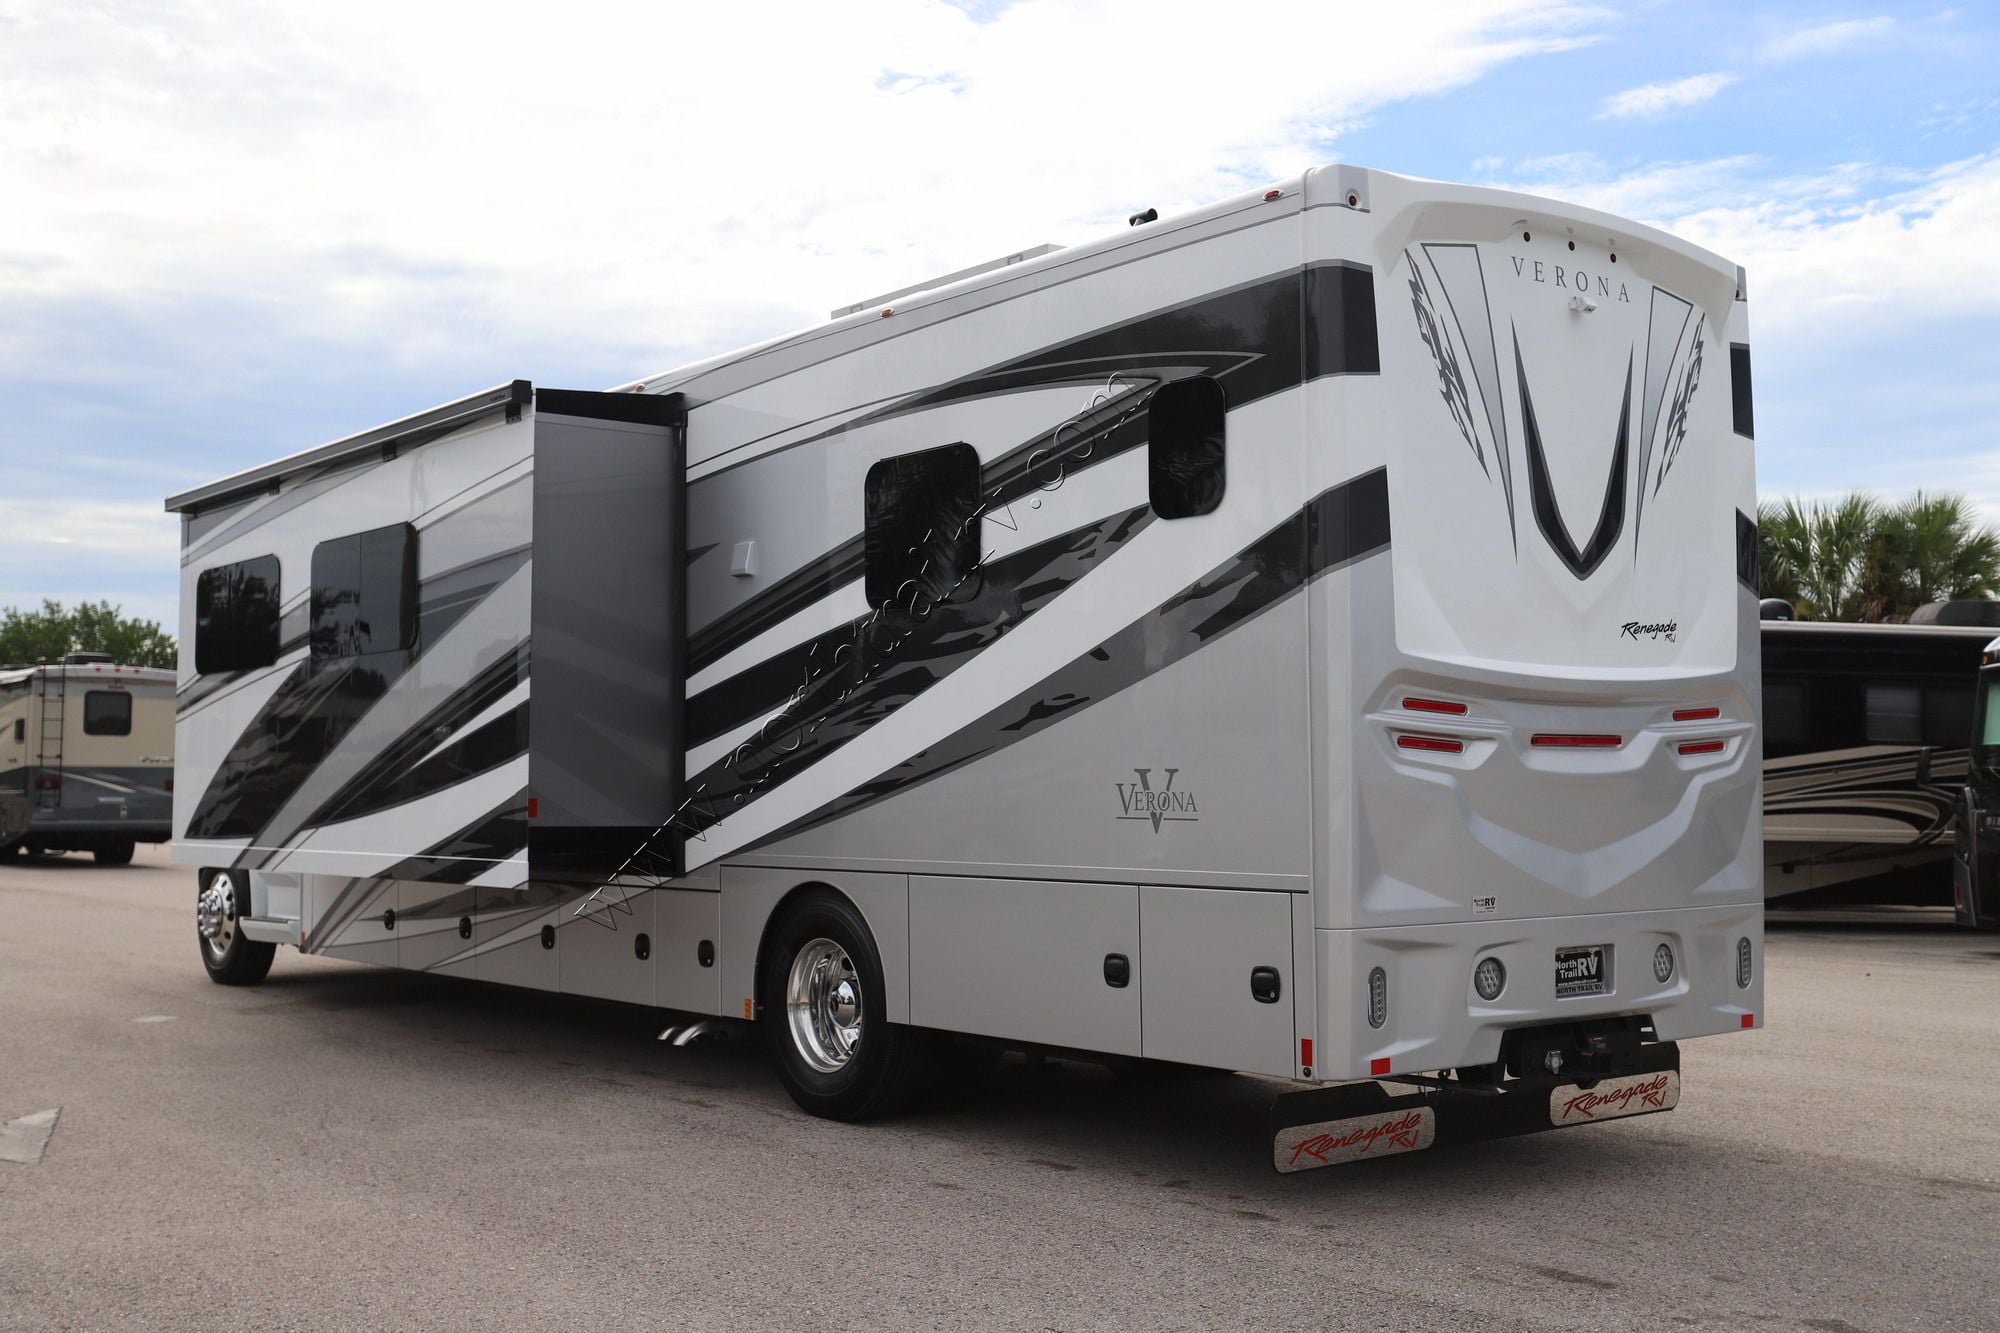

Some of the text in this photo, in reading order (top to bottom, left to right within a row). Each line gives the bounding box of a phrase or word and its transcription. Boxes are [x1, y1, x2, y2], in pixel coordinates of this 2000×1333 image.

[1511, 256, 1630, 303] VERONA
[1621, 618, 1677, 641] Renegade
[1664, 633, 1677, 643] RV
[1555, 956, 1598, 977] North RV
[1560, 969, 1577, 979] Trail
[1562, 1074, 1668, 1119] Renegade
[1641, 1091, 1666, 1108] RV
[1289, 1111, 1421, 1165] Renegade
[1388, 1129, 1419, 1149] RV
